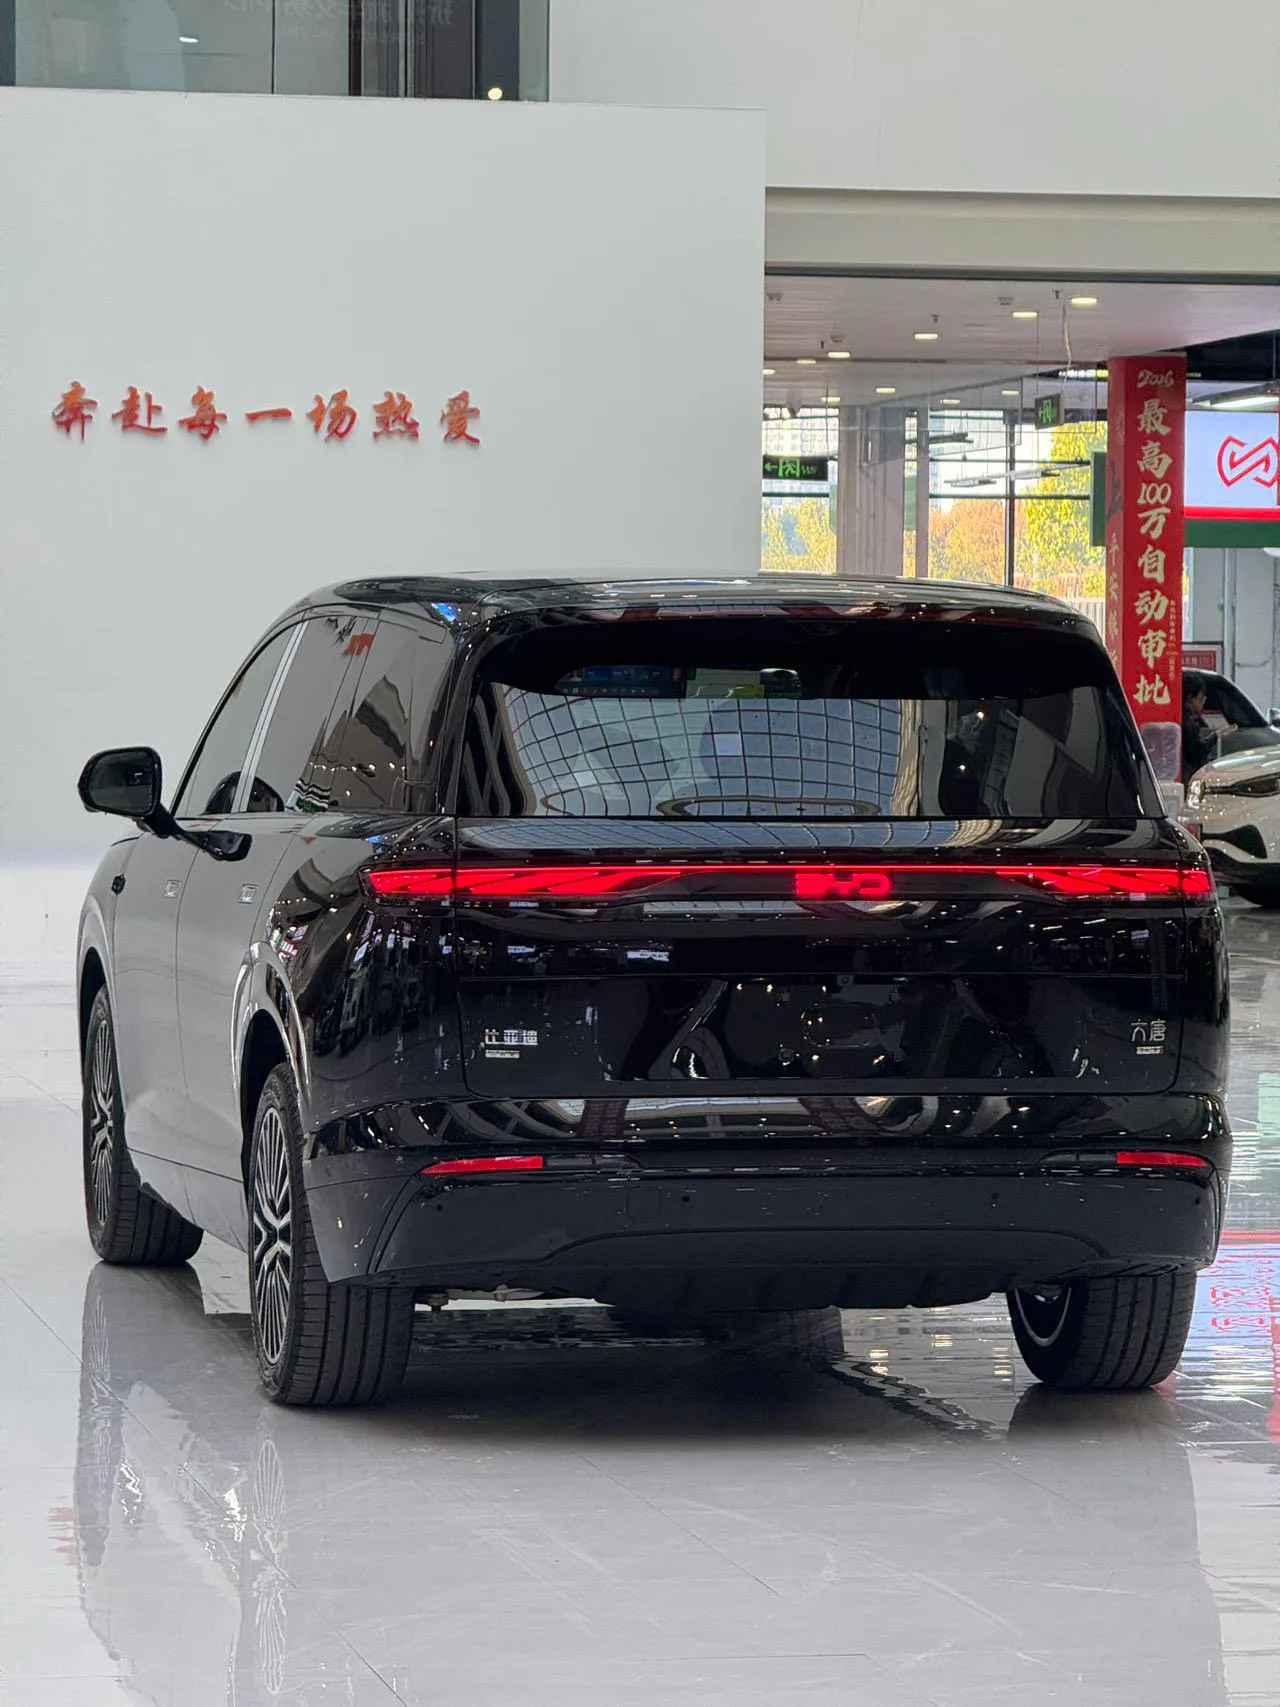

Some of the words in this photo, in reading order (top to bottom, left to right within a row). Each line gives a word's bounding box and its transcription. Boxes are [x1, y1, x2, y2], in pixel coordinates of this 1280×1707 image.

[52, 381, 481, 443] 奔赴每一场热爱
[794, 872, 891, 897] BYD
